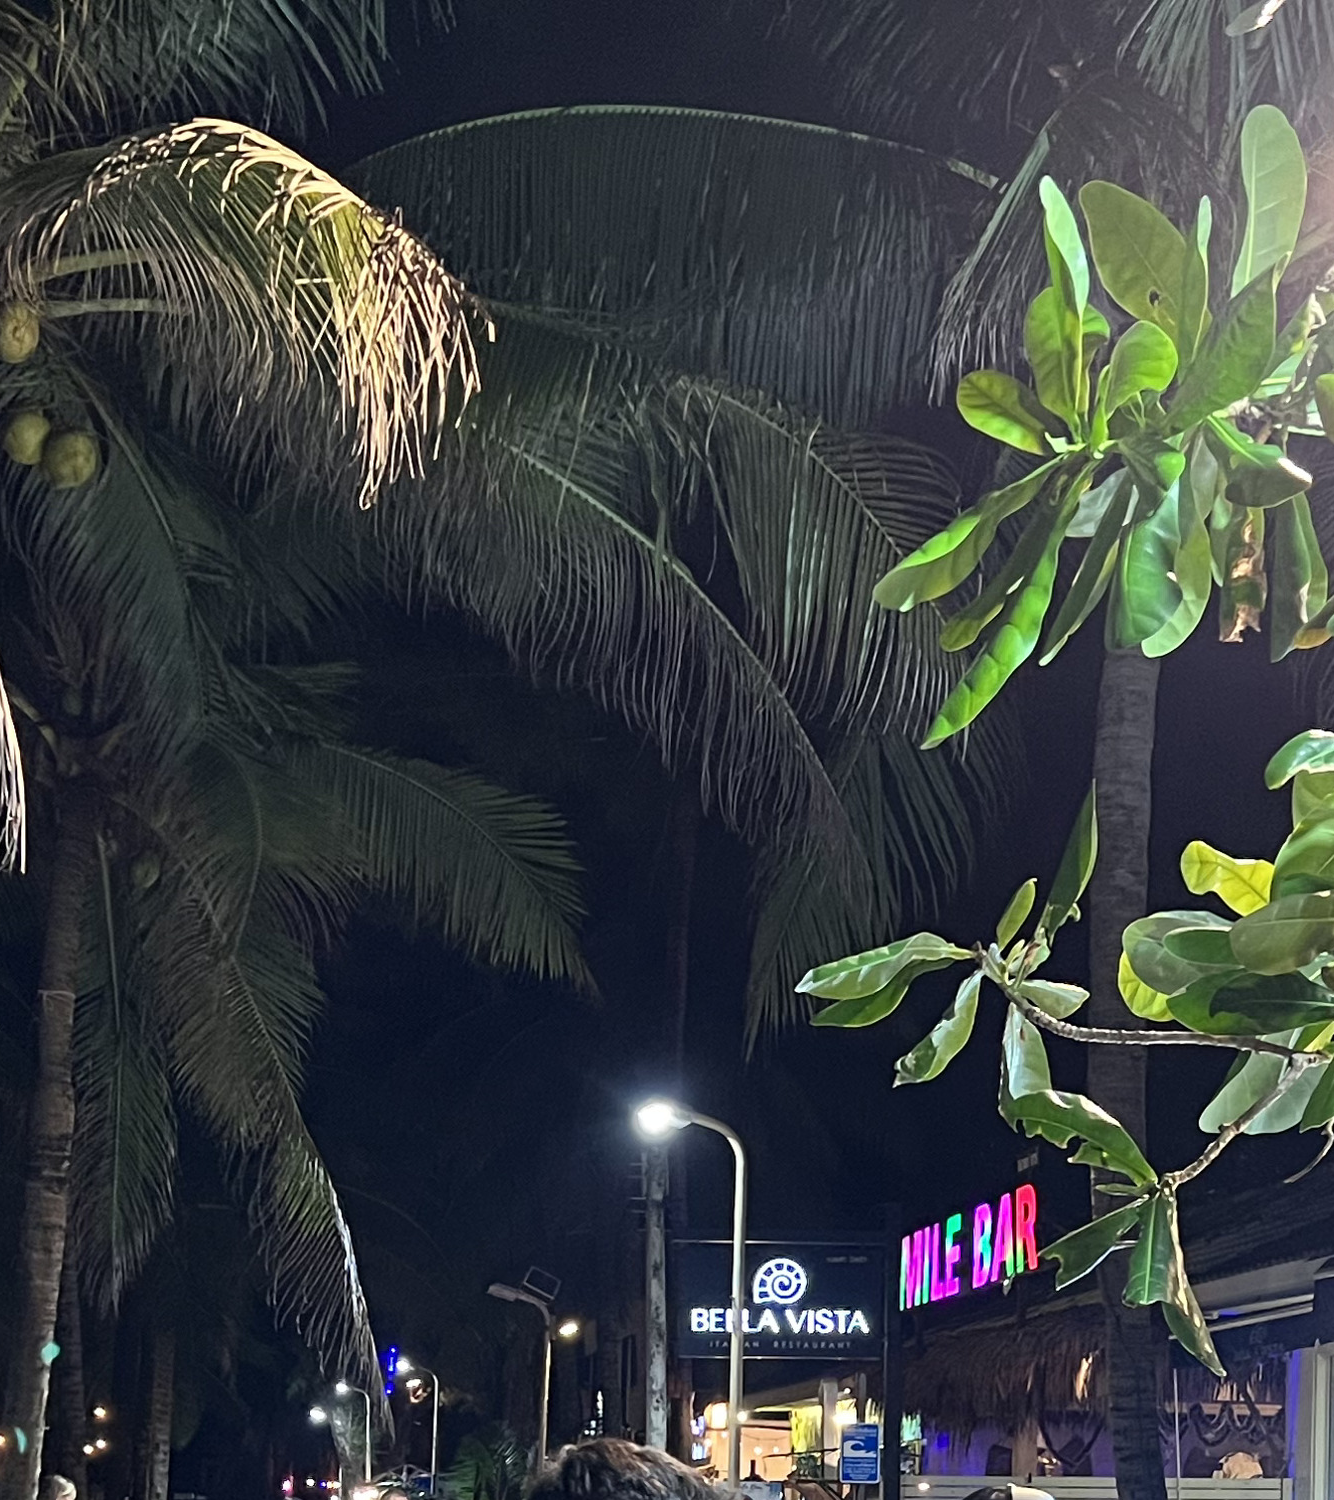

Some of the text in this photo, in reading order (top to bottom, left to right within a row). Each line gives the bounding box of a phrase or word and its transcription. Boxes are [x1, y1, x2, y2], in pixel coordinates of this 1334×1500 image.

[899, 1183, 1039, 1312] MILE BAR
[690, 1307, 870, 1334] BELLA VISTA
[710, 1340, 851, 1349] ITAAN RESTAURANT
